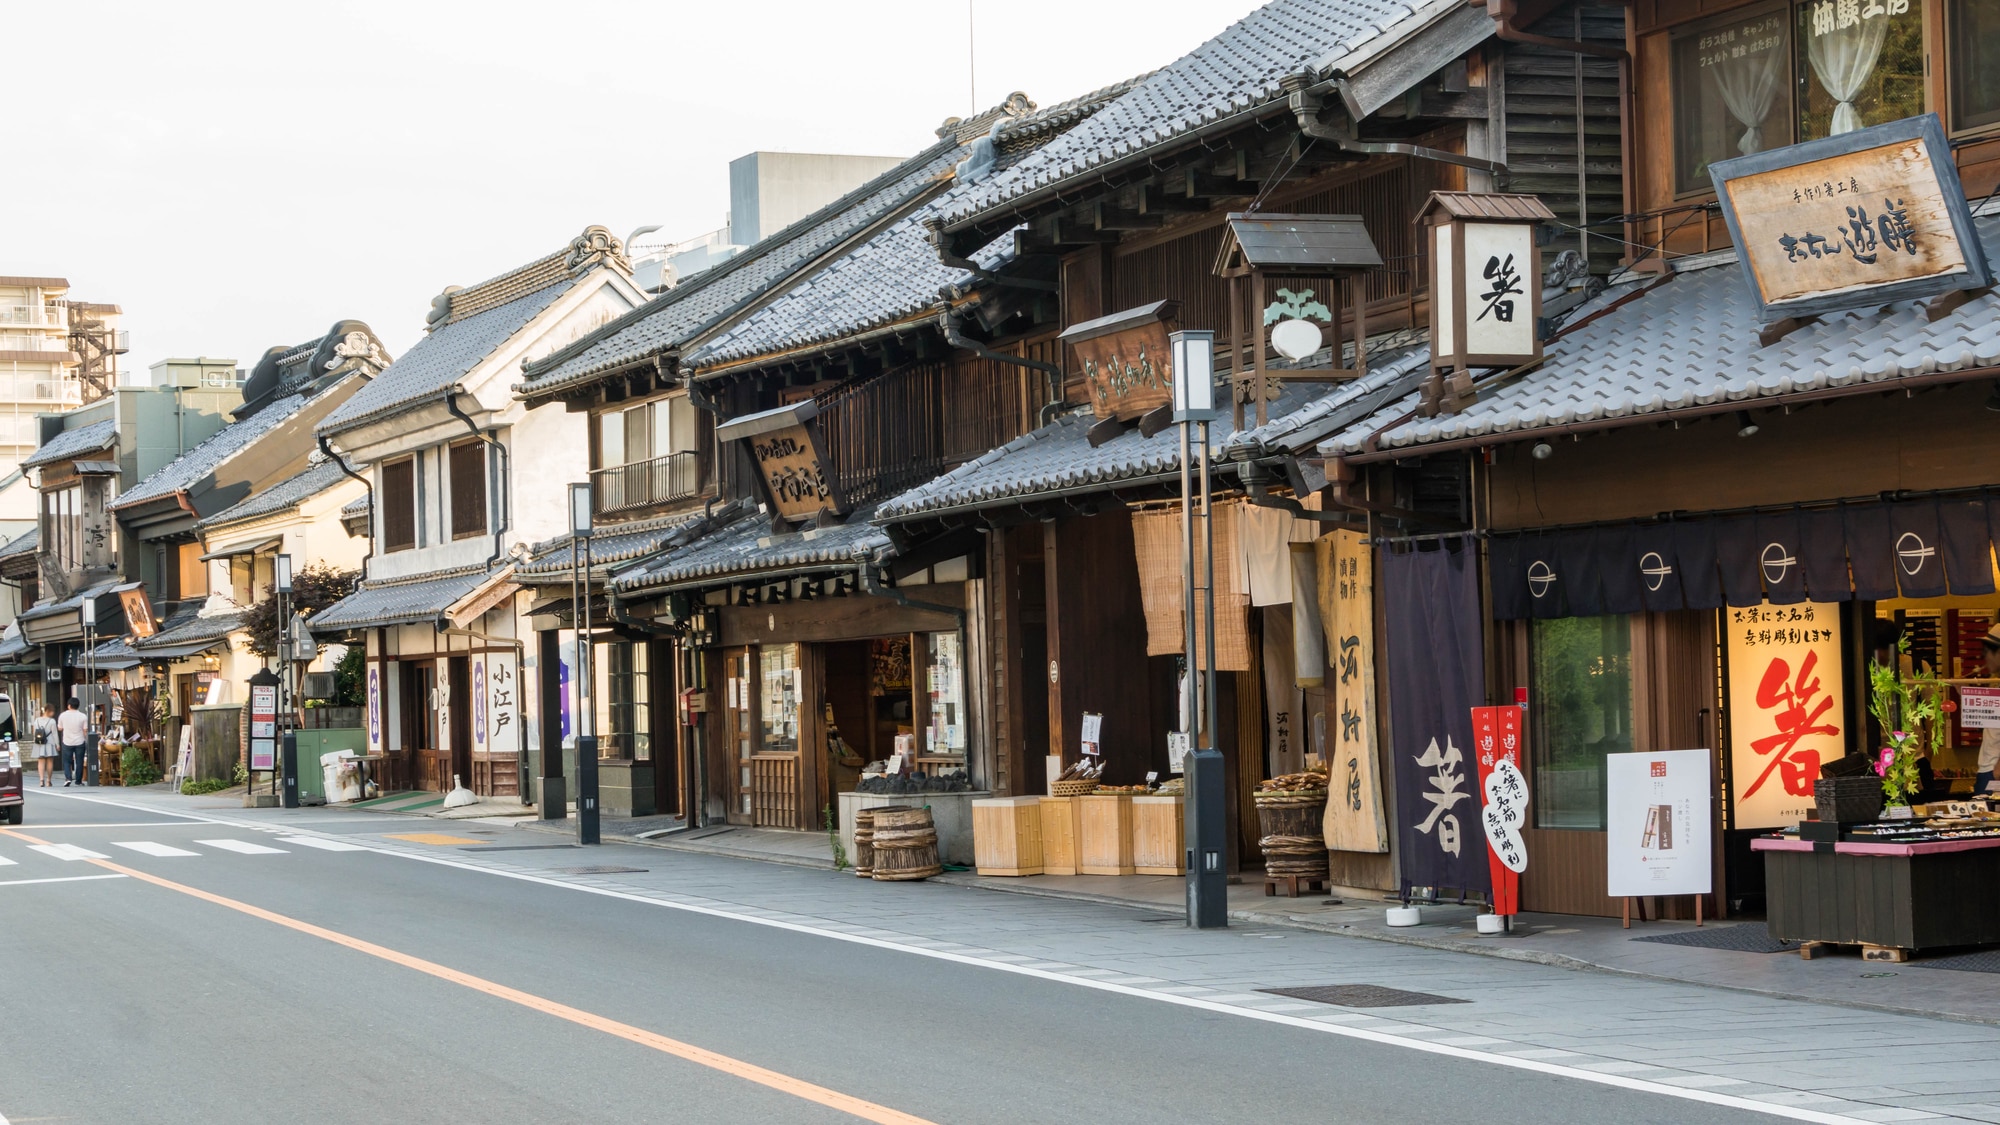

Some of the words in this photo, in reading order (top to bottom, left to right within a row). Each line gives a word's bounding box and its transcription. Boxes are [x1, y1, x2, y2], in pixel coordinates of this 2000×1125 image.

[1700, 50, 1728, 67] フェルト
[1750, 35, 1780, 54] はたおり
[1792, 176, 1859, 204] 手作り箸工房
[1475, 253, 1524, 323] 箸
[1339, 556, 1349, 600] 漬物
[1349, 556, 1358, 600] 創作
[1744, 628, 1833, 646] 無料彫刻します
[493, 663, 512, 737] 小江戸
[1506, 710, 1514, 730] 川越
[1276, 711, 1289, 753] 河村屋
[1482, 711, 1490, 732] 川越
[1737, 649, 1840, 805] 箸
[1411, 734, 1472, 859] 箸
[1779, 808, 1806, 816] 手作り箸工
